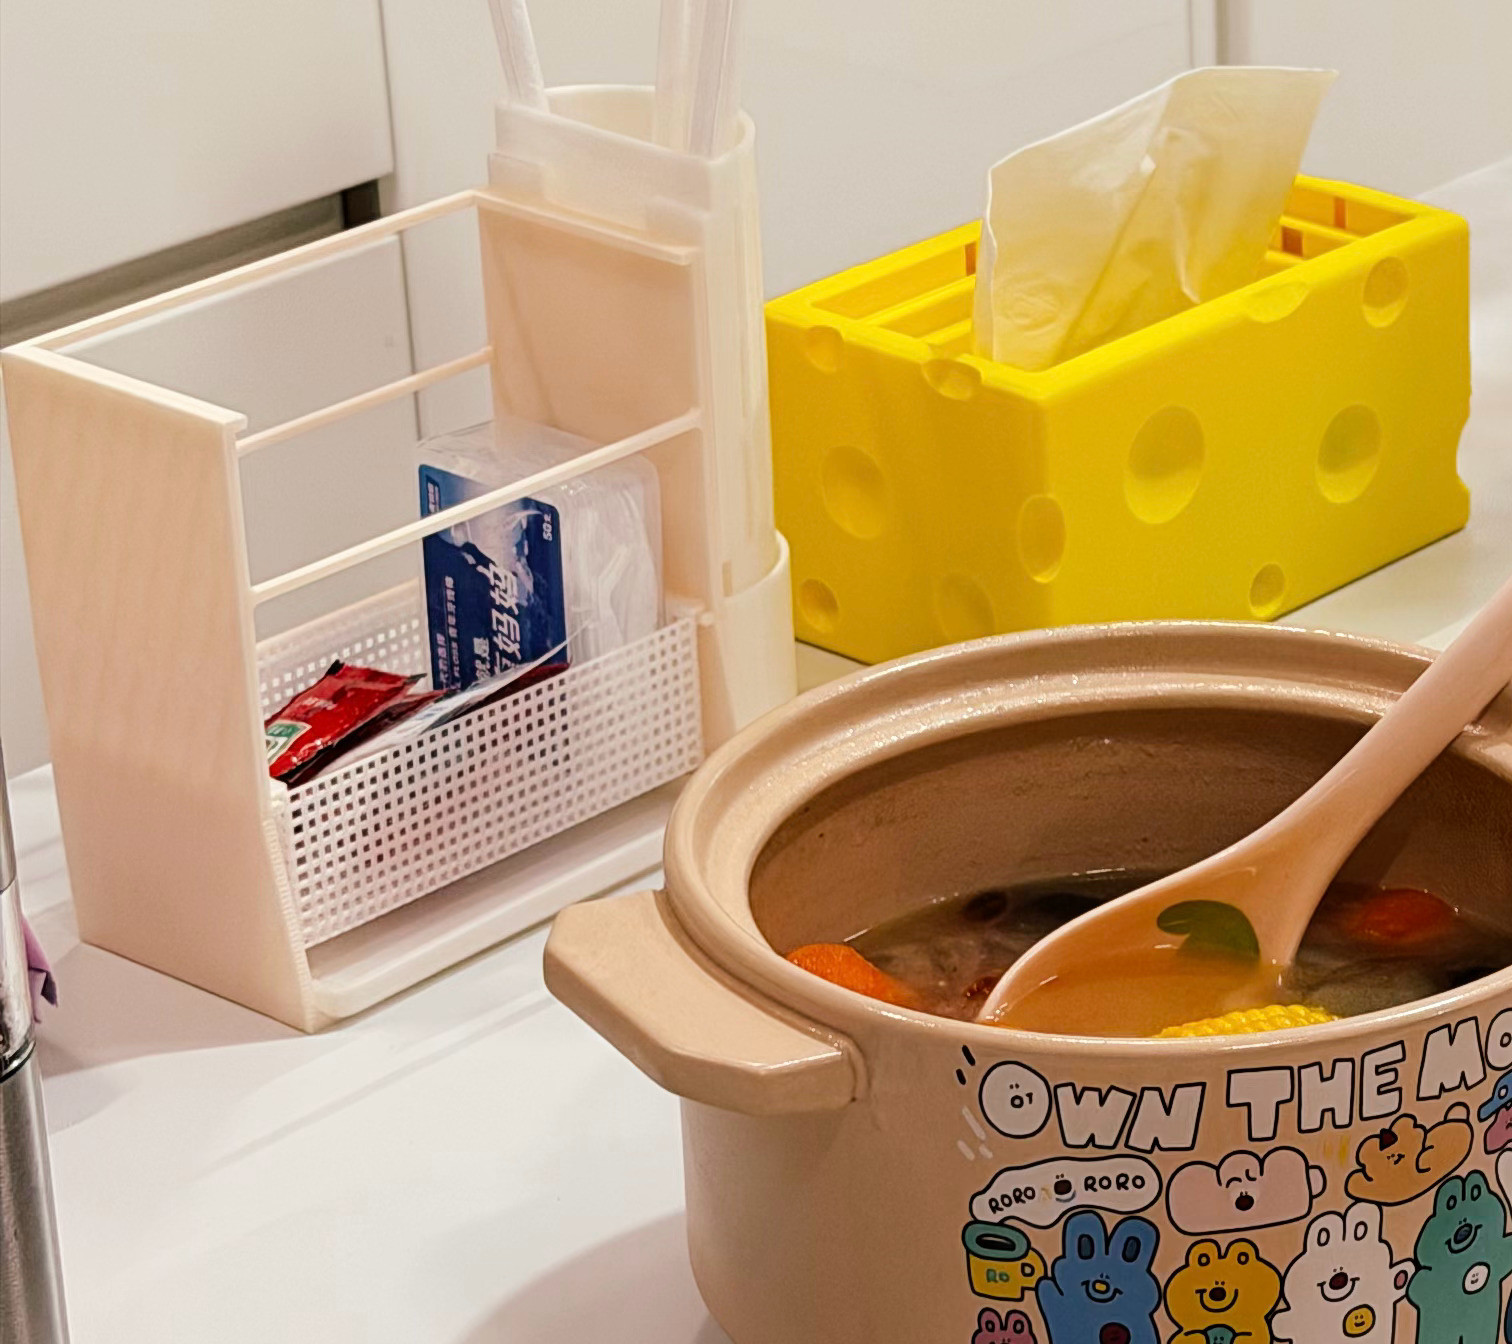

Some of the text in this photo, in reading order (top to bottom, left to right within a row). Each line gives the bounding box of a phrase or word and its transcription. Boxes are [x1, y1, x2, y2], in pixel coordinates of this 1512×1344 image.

[978, 1060, 1206, 1153] OWN
[1227, 1040, 1407, 1142] THE
[988, 1172, 1146, 1215] RORO RORO
